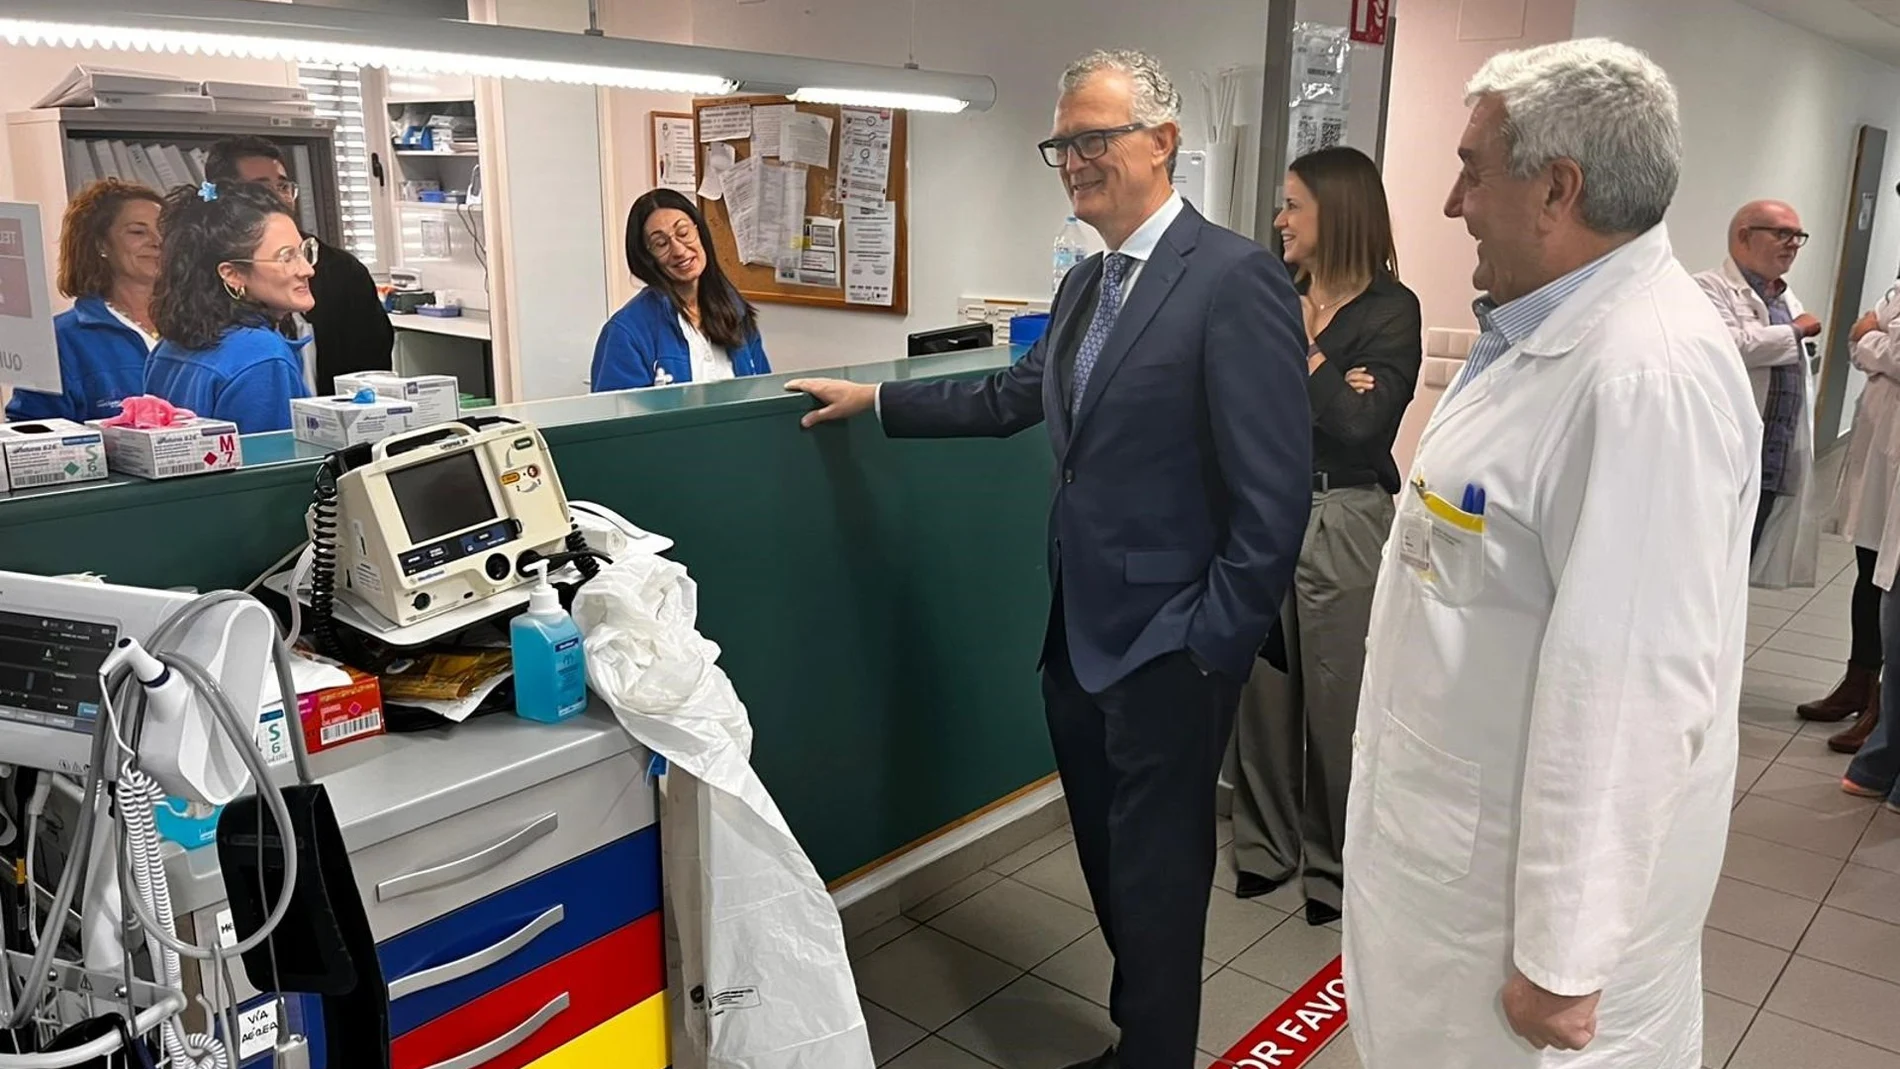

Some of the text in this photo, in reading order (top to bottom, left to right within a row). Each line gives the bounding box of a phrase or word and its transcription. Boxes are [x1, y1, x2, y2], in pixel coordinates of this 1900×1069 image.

[219, 435, 235, 452] M
[85, 444, 98, 462] S
[224, 452, 233, 463] 7
[88, 462, 97, 472] 6
[268, 723, 281, 742] S
[271, 742, 281, 753] 6
